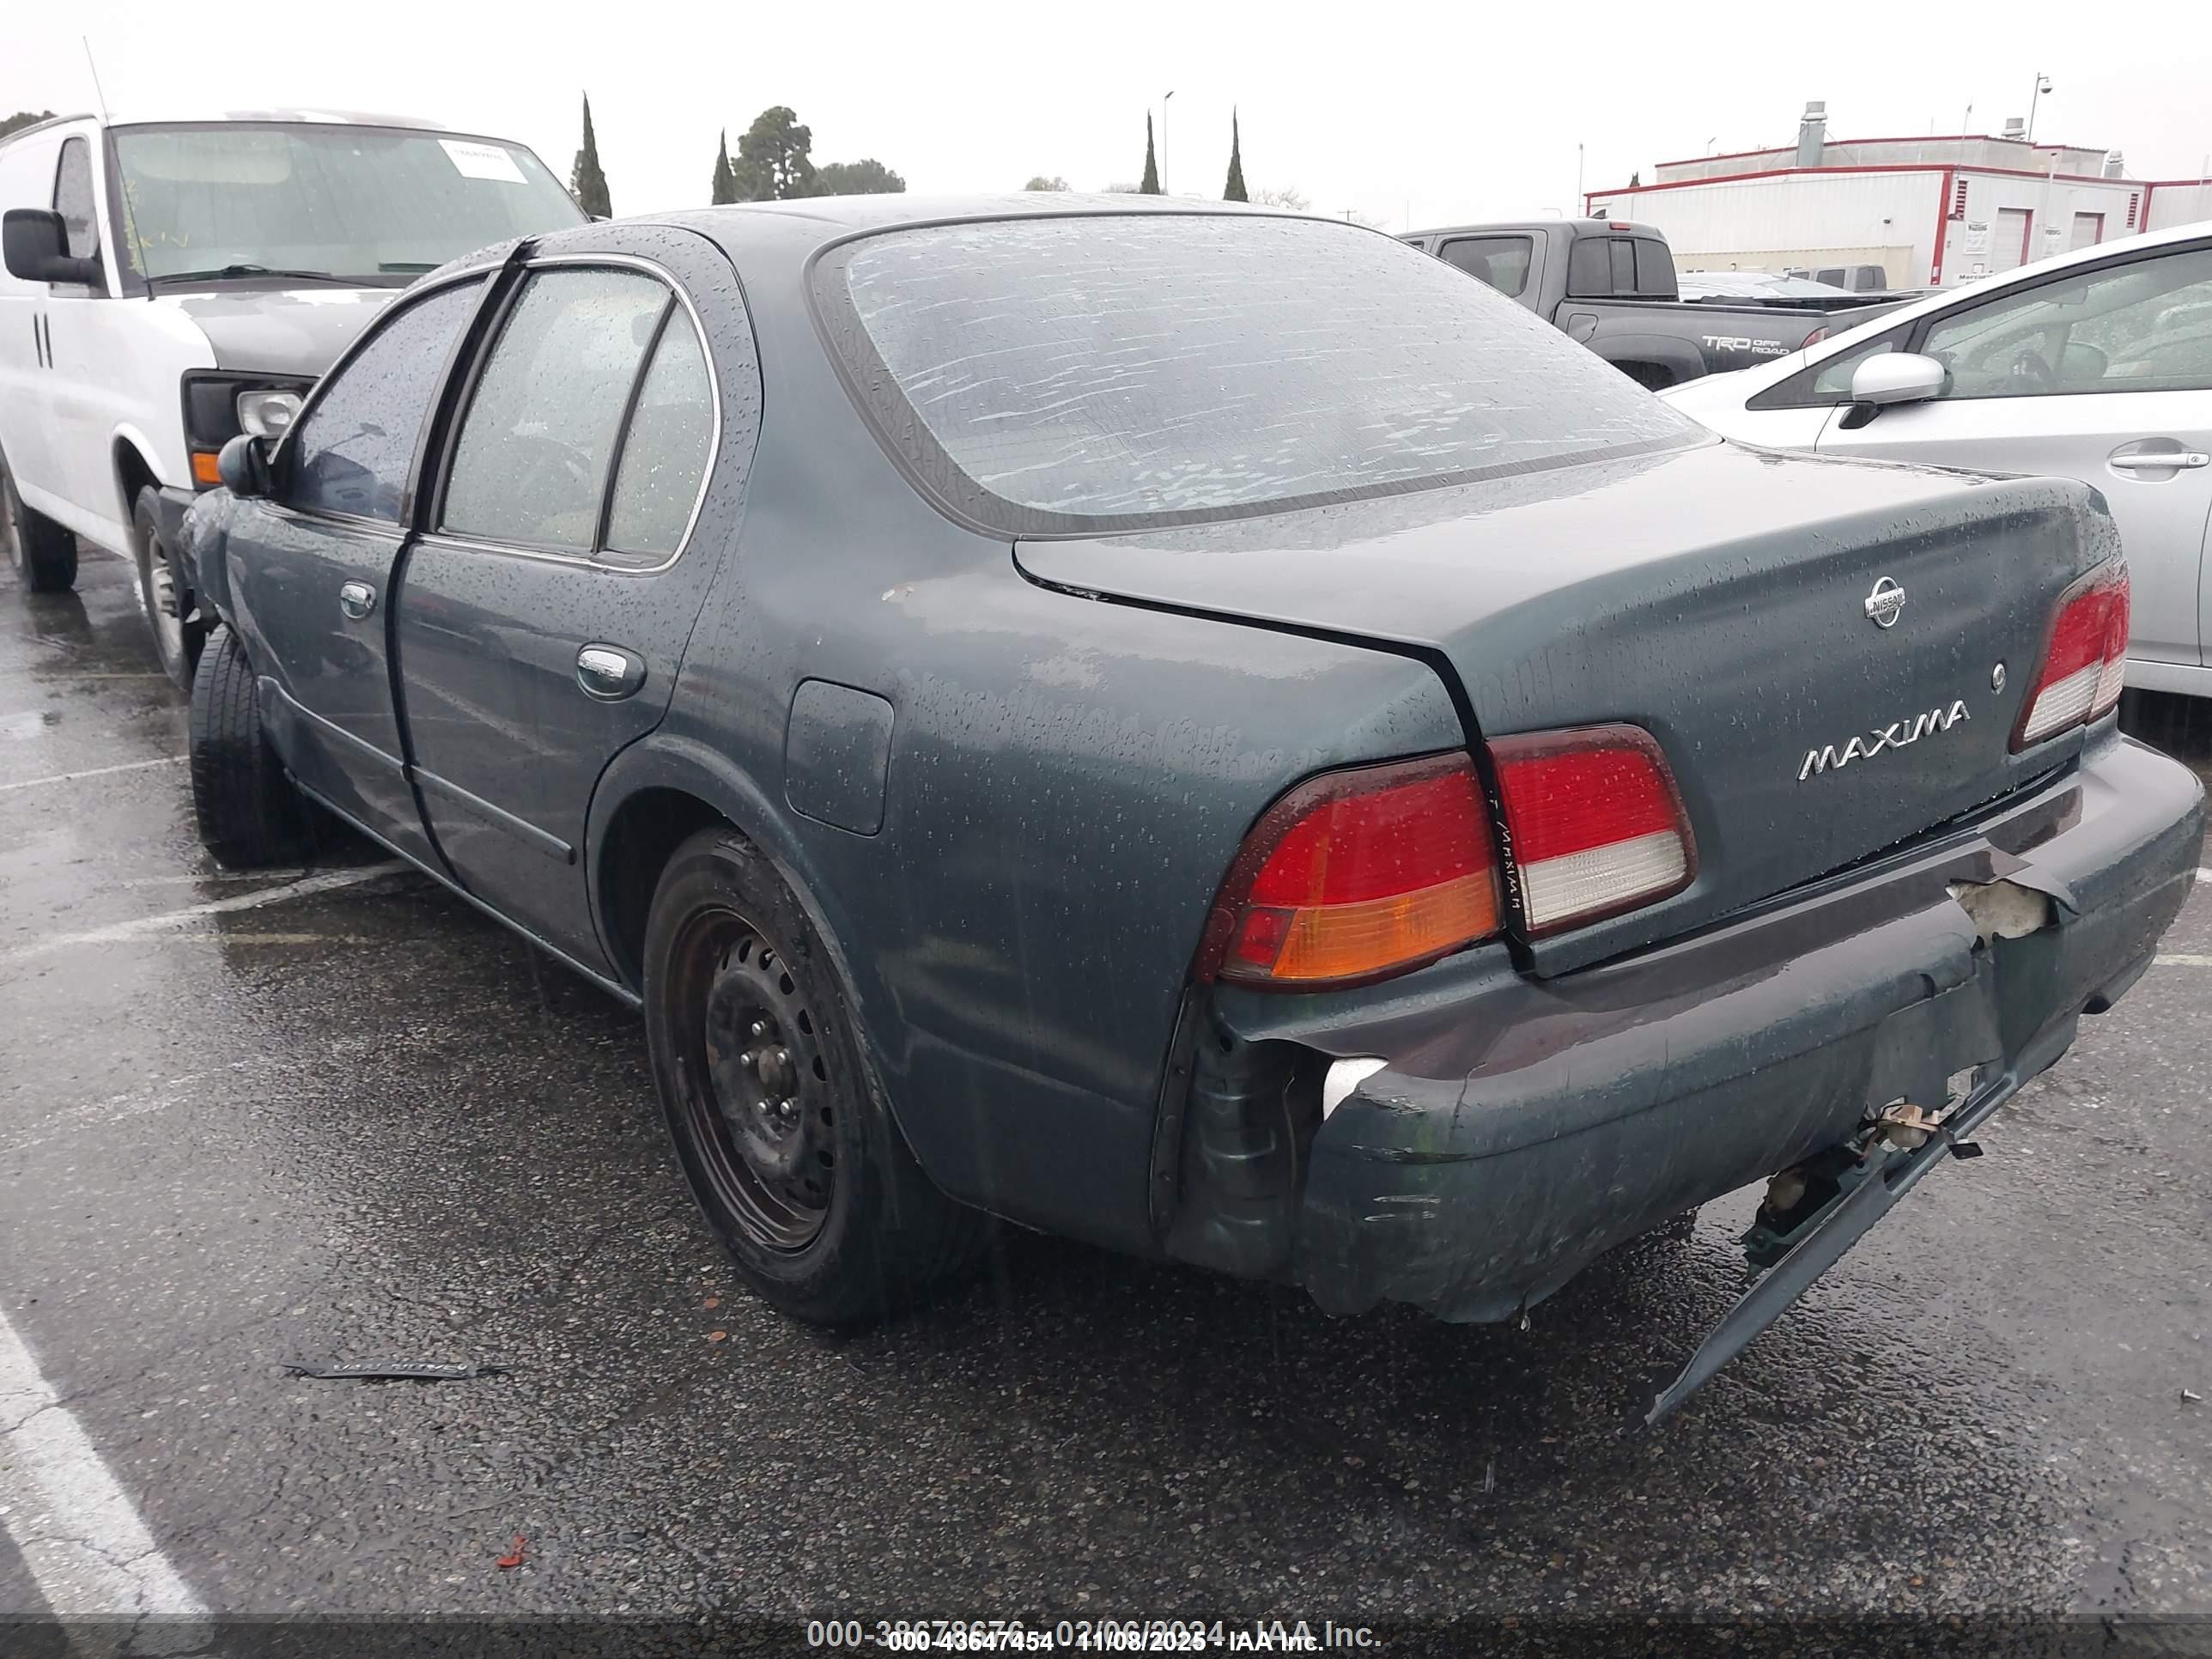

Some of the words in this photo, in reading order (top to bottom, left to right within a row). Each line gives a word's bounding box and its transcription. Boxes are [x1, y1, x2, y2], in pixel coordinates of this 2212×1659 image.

[1702, 336, 1752, 351] TRD
[1873, 592, 1903, 612] NISSAN
[1796, 699, 1972, 781] MAXIMA
